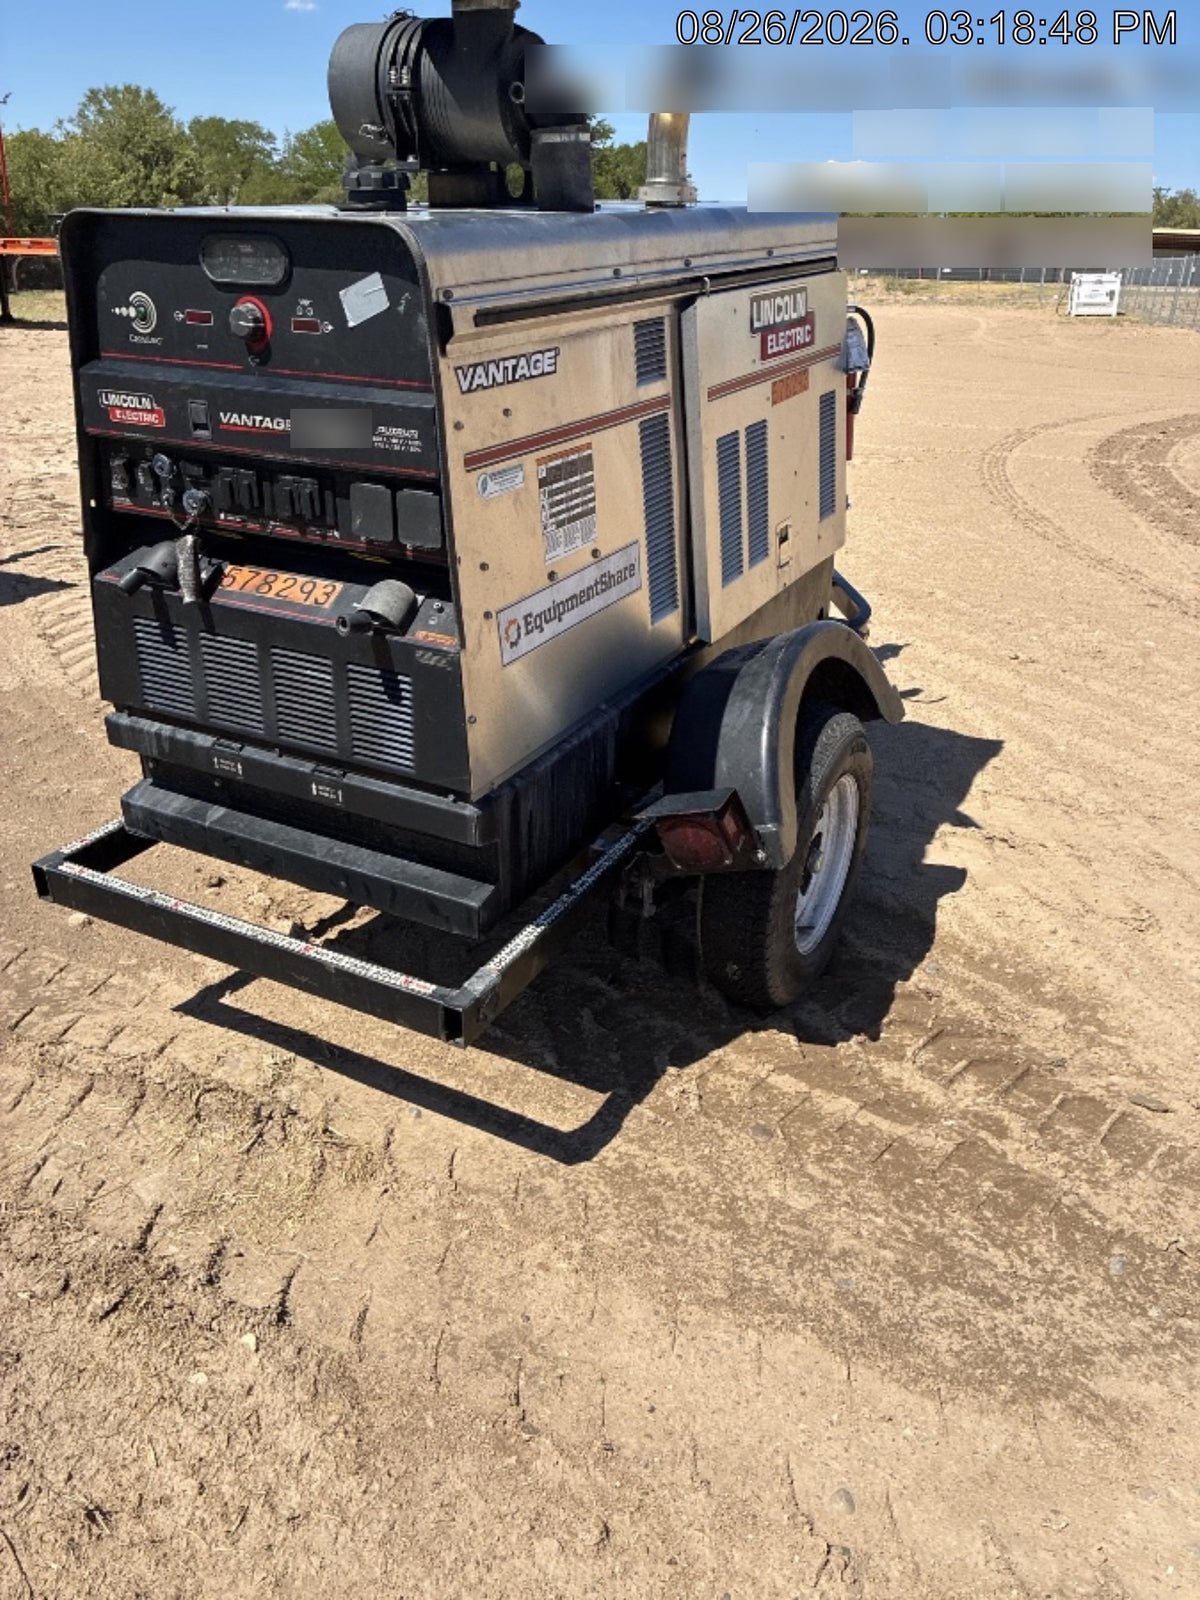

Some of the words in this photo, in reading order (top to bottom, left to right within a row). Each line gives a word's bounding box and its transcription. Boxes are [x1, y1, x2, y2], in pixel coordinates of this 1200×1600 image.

[752, 290, 807, 330] LINCOLN
[766, 324, 812, 355] ELECTRIC
[456, 349, 557, 393] VANTAGE
[101, 391, 152, 410] LINCOLN
[115, 409, 160, 424] ELECTRIC
[221, 567, 337, 606] 578293
[523, 562, 636, 637] EquipmentShare
